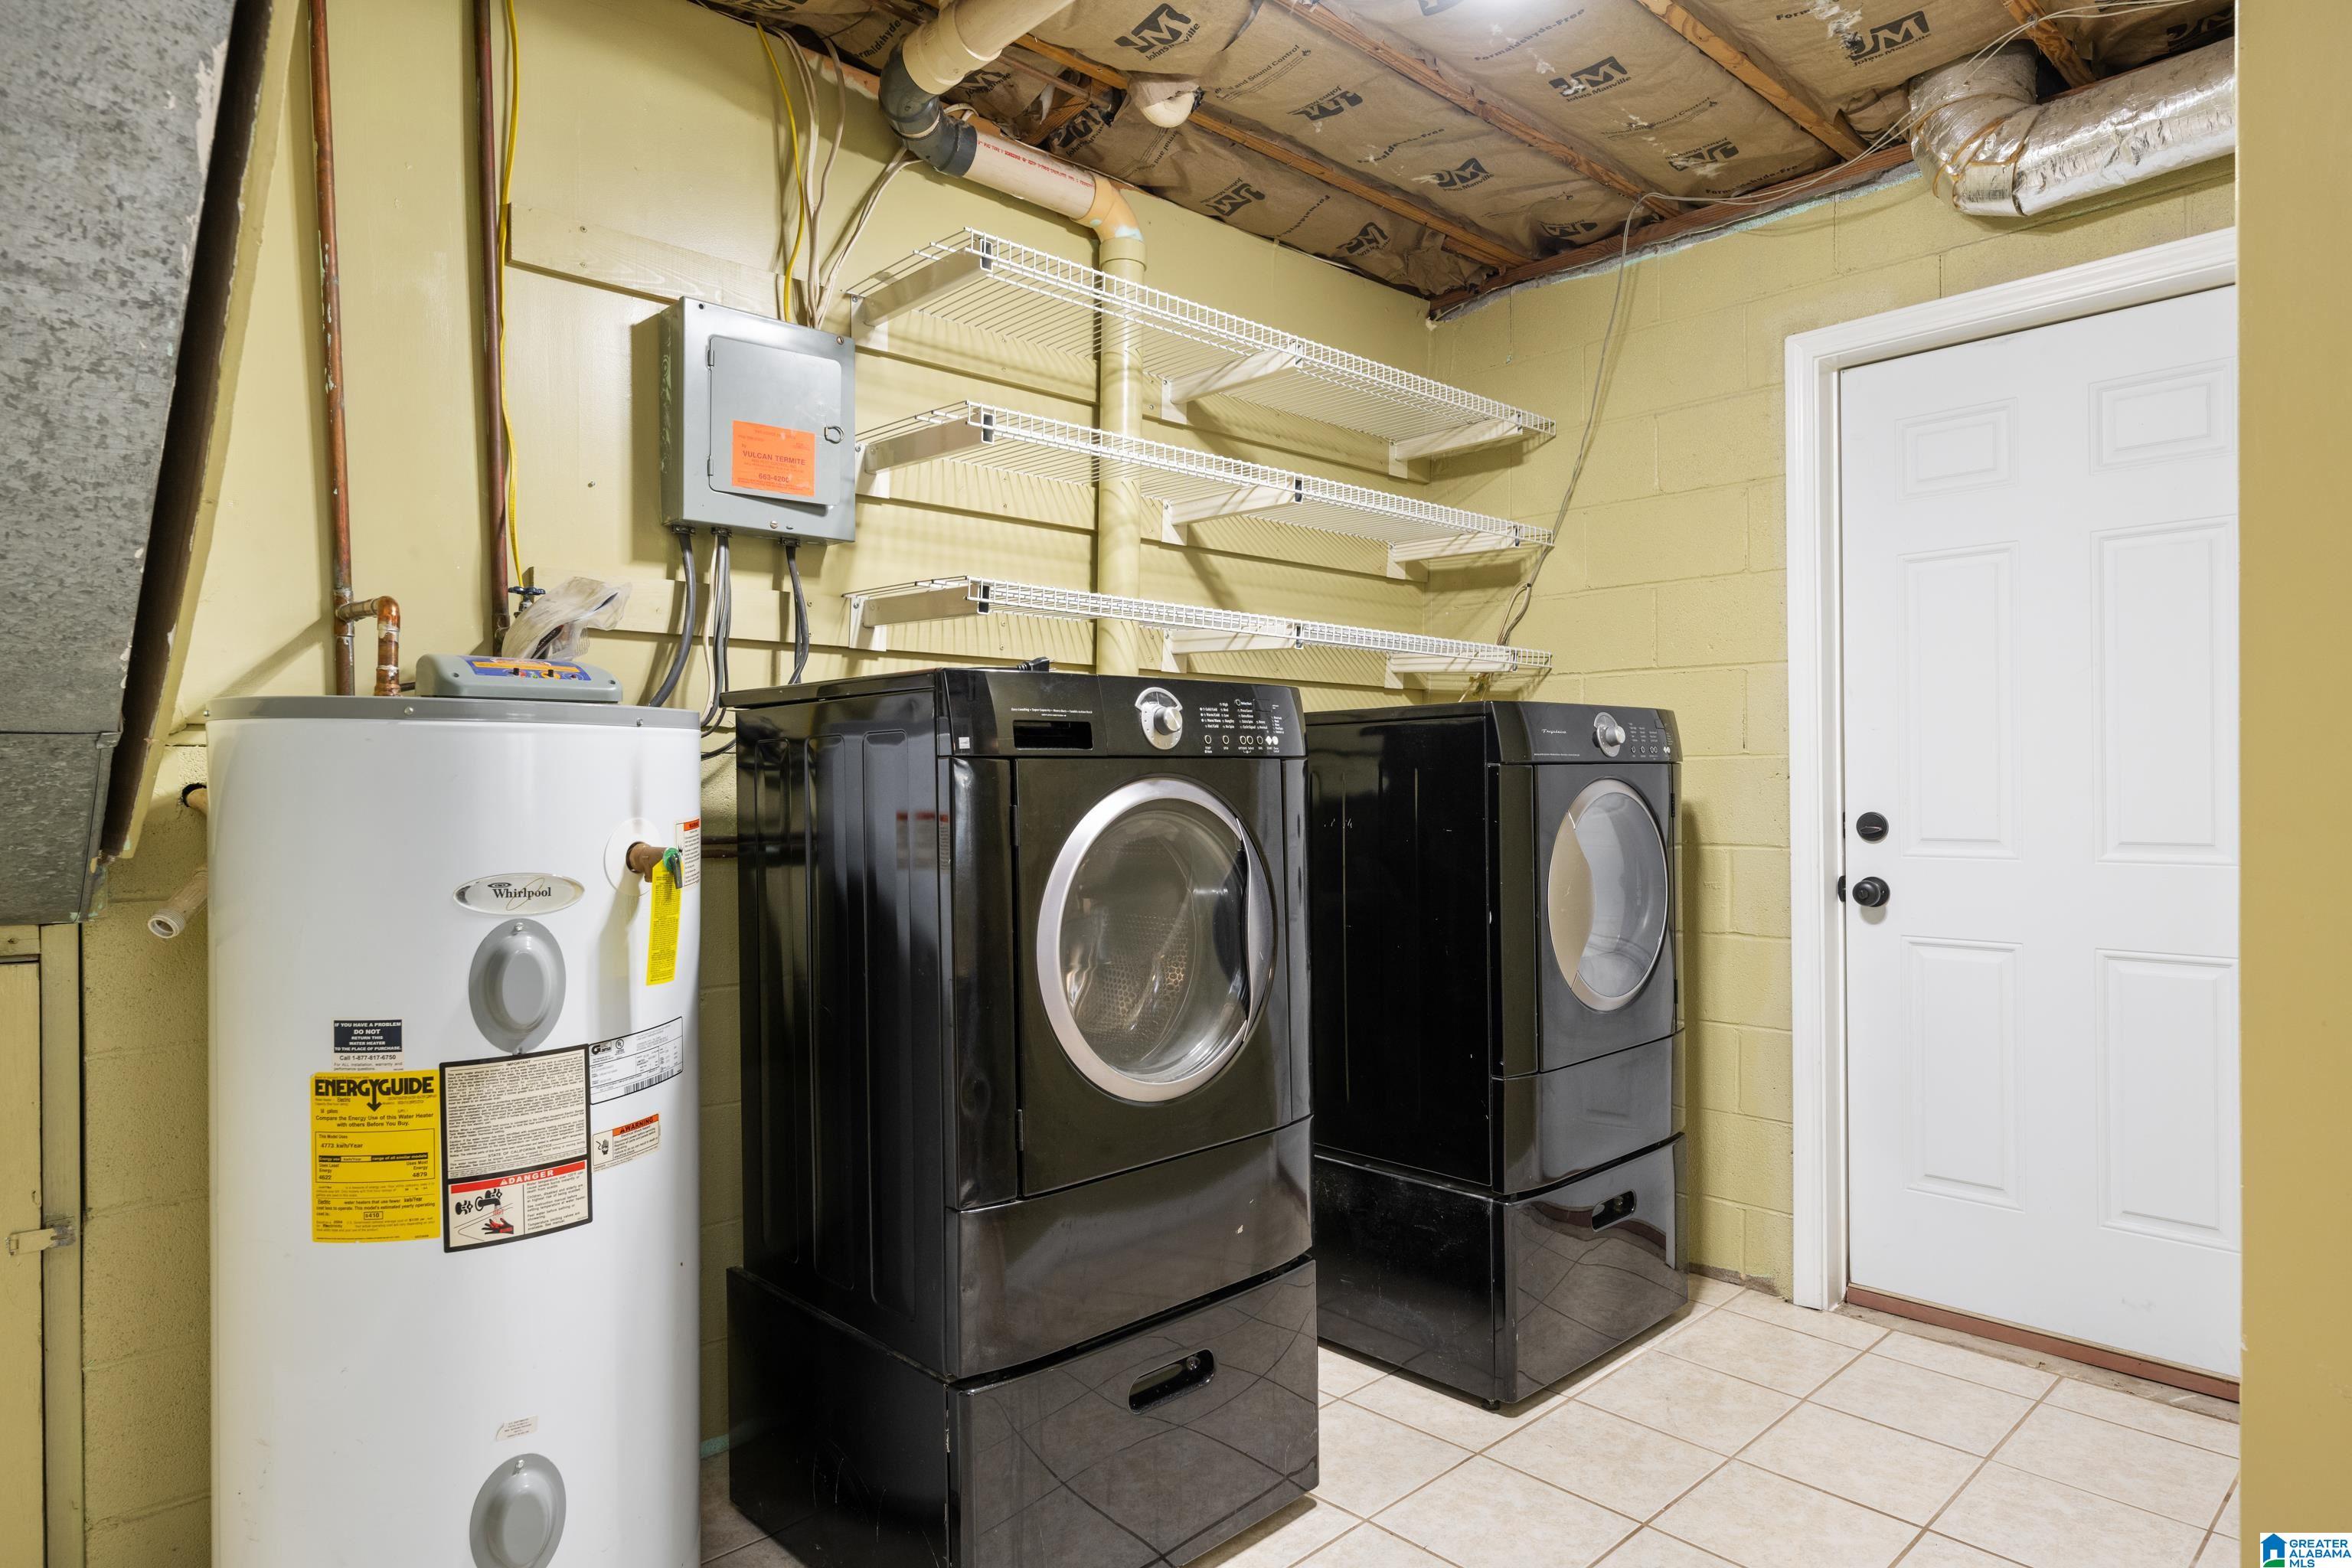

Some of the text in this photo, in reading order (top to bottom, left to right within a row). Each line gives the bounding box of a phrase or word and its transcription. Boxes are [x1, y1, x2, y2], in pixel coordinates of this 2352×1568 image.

[1474, 8, 1585, 61] Formaldehyde-Free
[1853, 33, 1932, 67] Johns Manville
[1248, 64, 1272, 81] Sound
[1272, 44, 1301, 66] Control
[1566, 75, 1632, 103] Johns Manville
[1678, 96, 1711, 116] Control
[1462, 172, 1494, 191] Manville
[743, 450, 806, 466] VULCAN TERMITE
[492, 887, 552, 902] Whirlpool
[315, 1076, 434, 1096] ENERGYGUIDE
[625, 1116, 654, 1132] WARNING
[508, 1169, 554, 1185] DANGER
